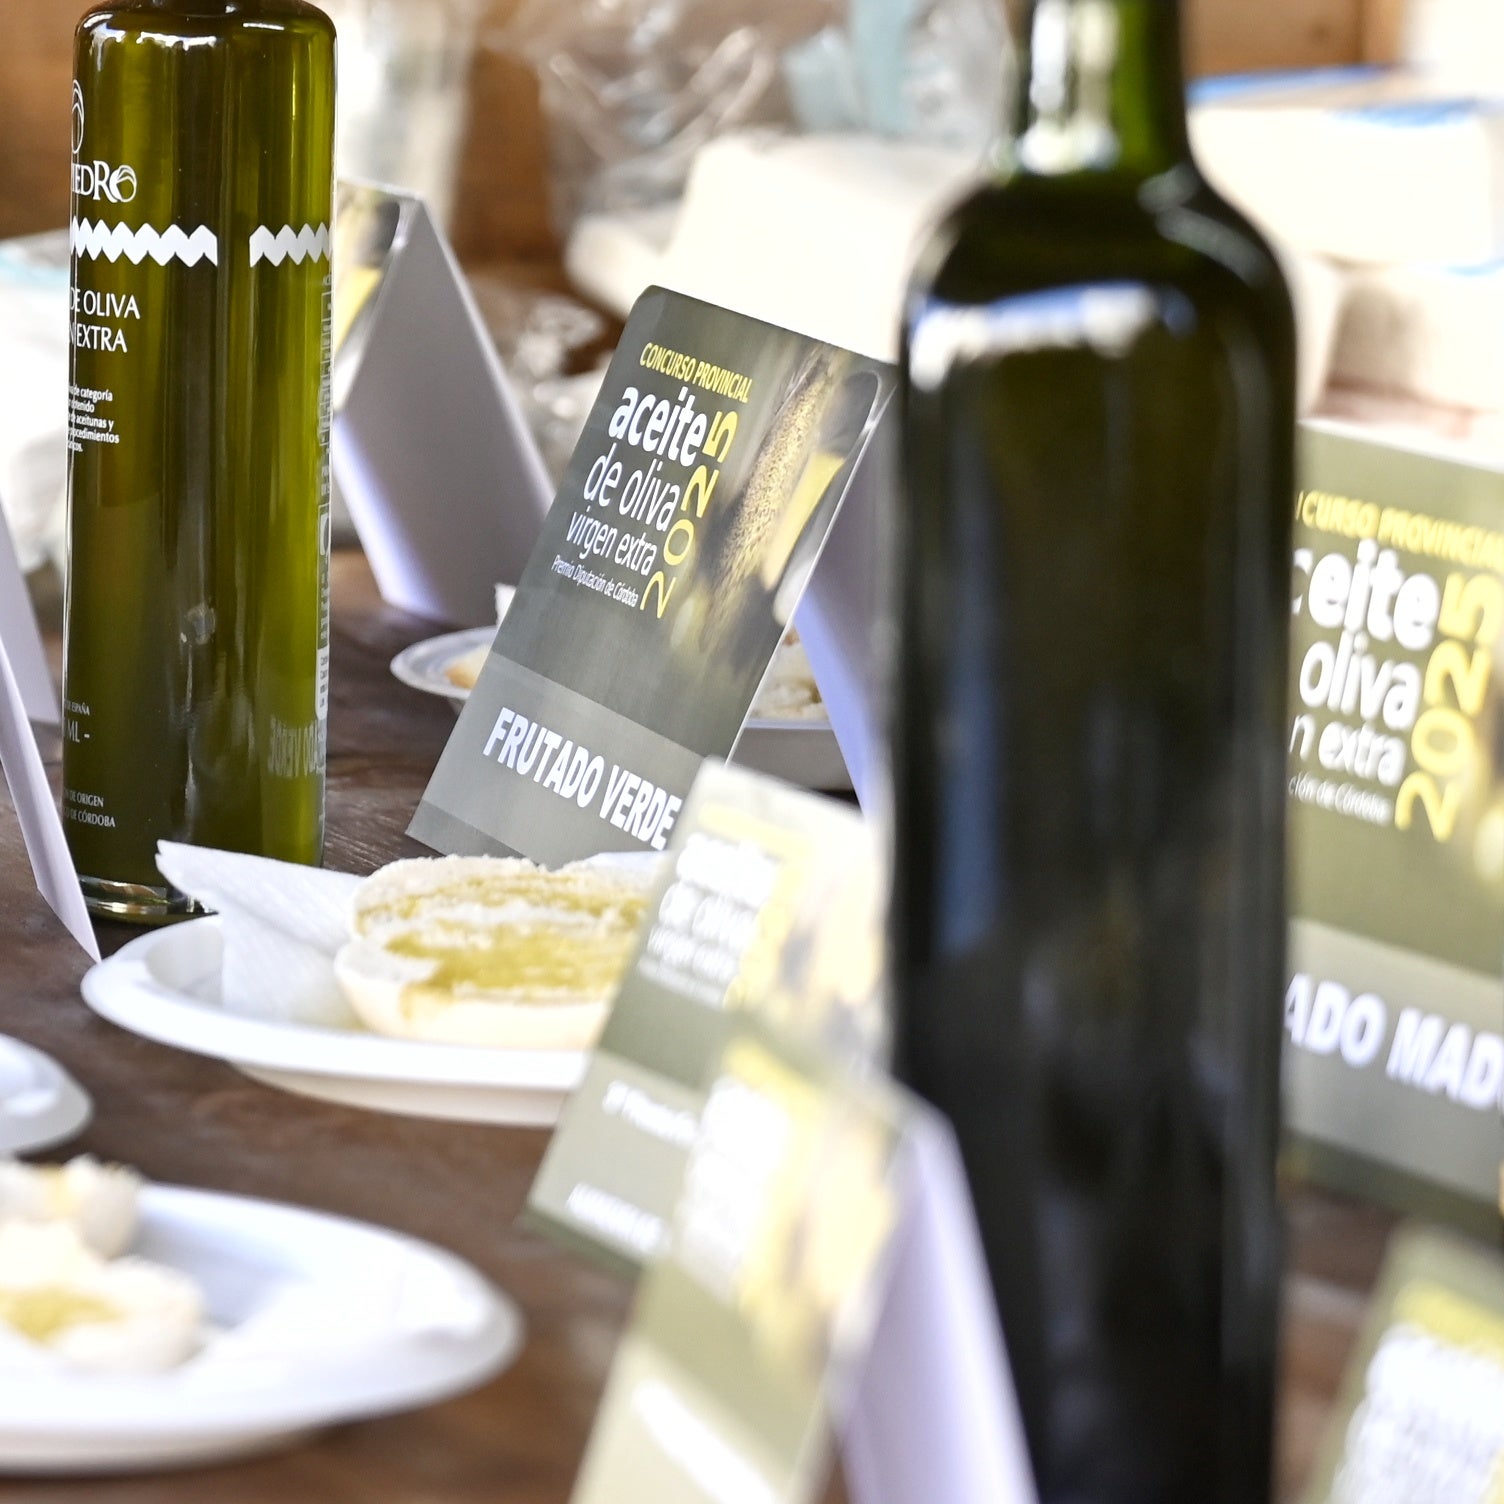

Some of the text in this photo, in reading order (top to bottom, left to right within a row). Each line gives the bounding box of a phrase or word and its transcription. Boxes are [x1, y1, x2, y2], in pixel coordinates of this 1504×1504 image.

[83, 290, 141, 320] OLIVA
[76, 323, 128, 353] EXTRA
[80, 387, 113, 404] categoría
[639, 342, 753, 404] CONCURSO PROVINCIAL
[108, 419, 115, 432] y
[608, 385, 708, 467] aceite
[583, 442, 681, 532] de oliva
[639, 410, 739, 619] 2025
[1295, 489, 1382, 540] CURSO
[566, 506, 658, 576] virgen extra
[551, 554, 639, 608] Premio Diputación de Córdoba
[1298, 630, 1423, 732] oliva
[1394, 571, 1504, 843] 2025
[483, 707, 605, 809] FRUTADO
[599, 764, 683, 851] VERDE
[1317, 719, 1407, 788] extra
[77, 791, 104, 807] ORIGEN
[78, 809, 116, 828] CÓRDOBA
[1385, 1007, 1504, 1112] MAD
